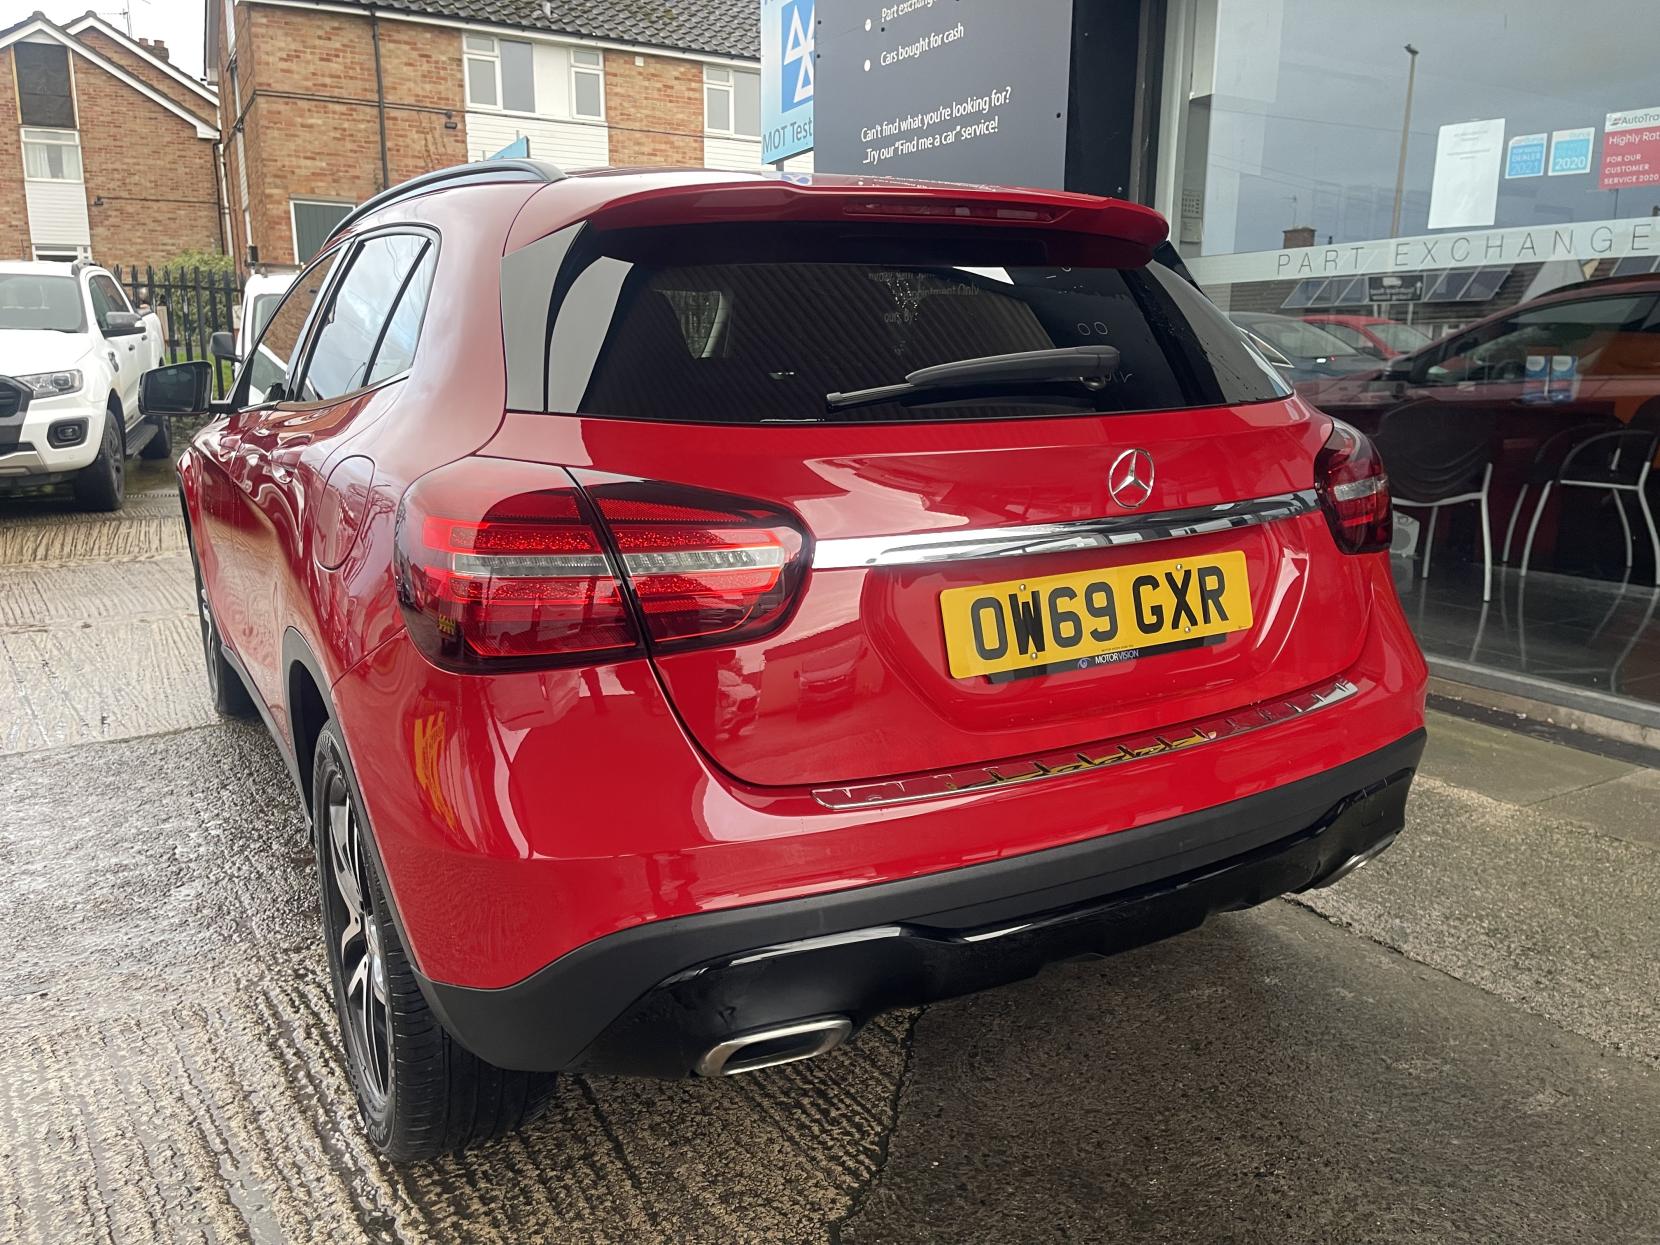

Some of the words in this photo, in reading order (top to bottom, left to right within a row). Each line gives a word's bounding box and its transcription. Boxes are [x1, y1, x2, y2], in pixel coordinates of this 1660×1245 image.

[881, 5, 898, 22] Part
[898, 0, 936, 15] exchang
[880, 51, 897, 65] Cars
[898, 37, 929, 58] bought
[929, 32, 943, 48] for
[943, 22, 964, 43] cash
[861, 125, 882, 142] Can't
[882, 118, 899, 137] find
[900, 114, 922, 132] what
[923, 106, 951, 130] you're
[952, 96, 989, 114] looking
[991, 86, 1011, 107] for?
[763, 125, 788, 154] MOT
[880, 146, 895, 160] our
[918, 135, 933, 150] me
[934, 133, 941, 146] a
[961, 116, 999, 140] service!
[1609, 133, 1640, 145] Highly
[1555, 156, 1586, 170] 2020
[1605, 164, 1649, 174] CUSTOMER
[1607, 155, 1622, 163] FOR
[1624, 153, 1641, 162] OUR
[1604, 175, 1637, 185] SERVICE
[1638, 173, 1659, 182] 2020
[1277, 247, 1365, 276] PART
[1394, 223, 1652, 267] EXCHANGE
[971, 581, 1119, 661] OW69
[1131, 565, 1230, 635] GXR
[1095, 649, 1139, 664] MOTORVISION
